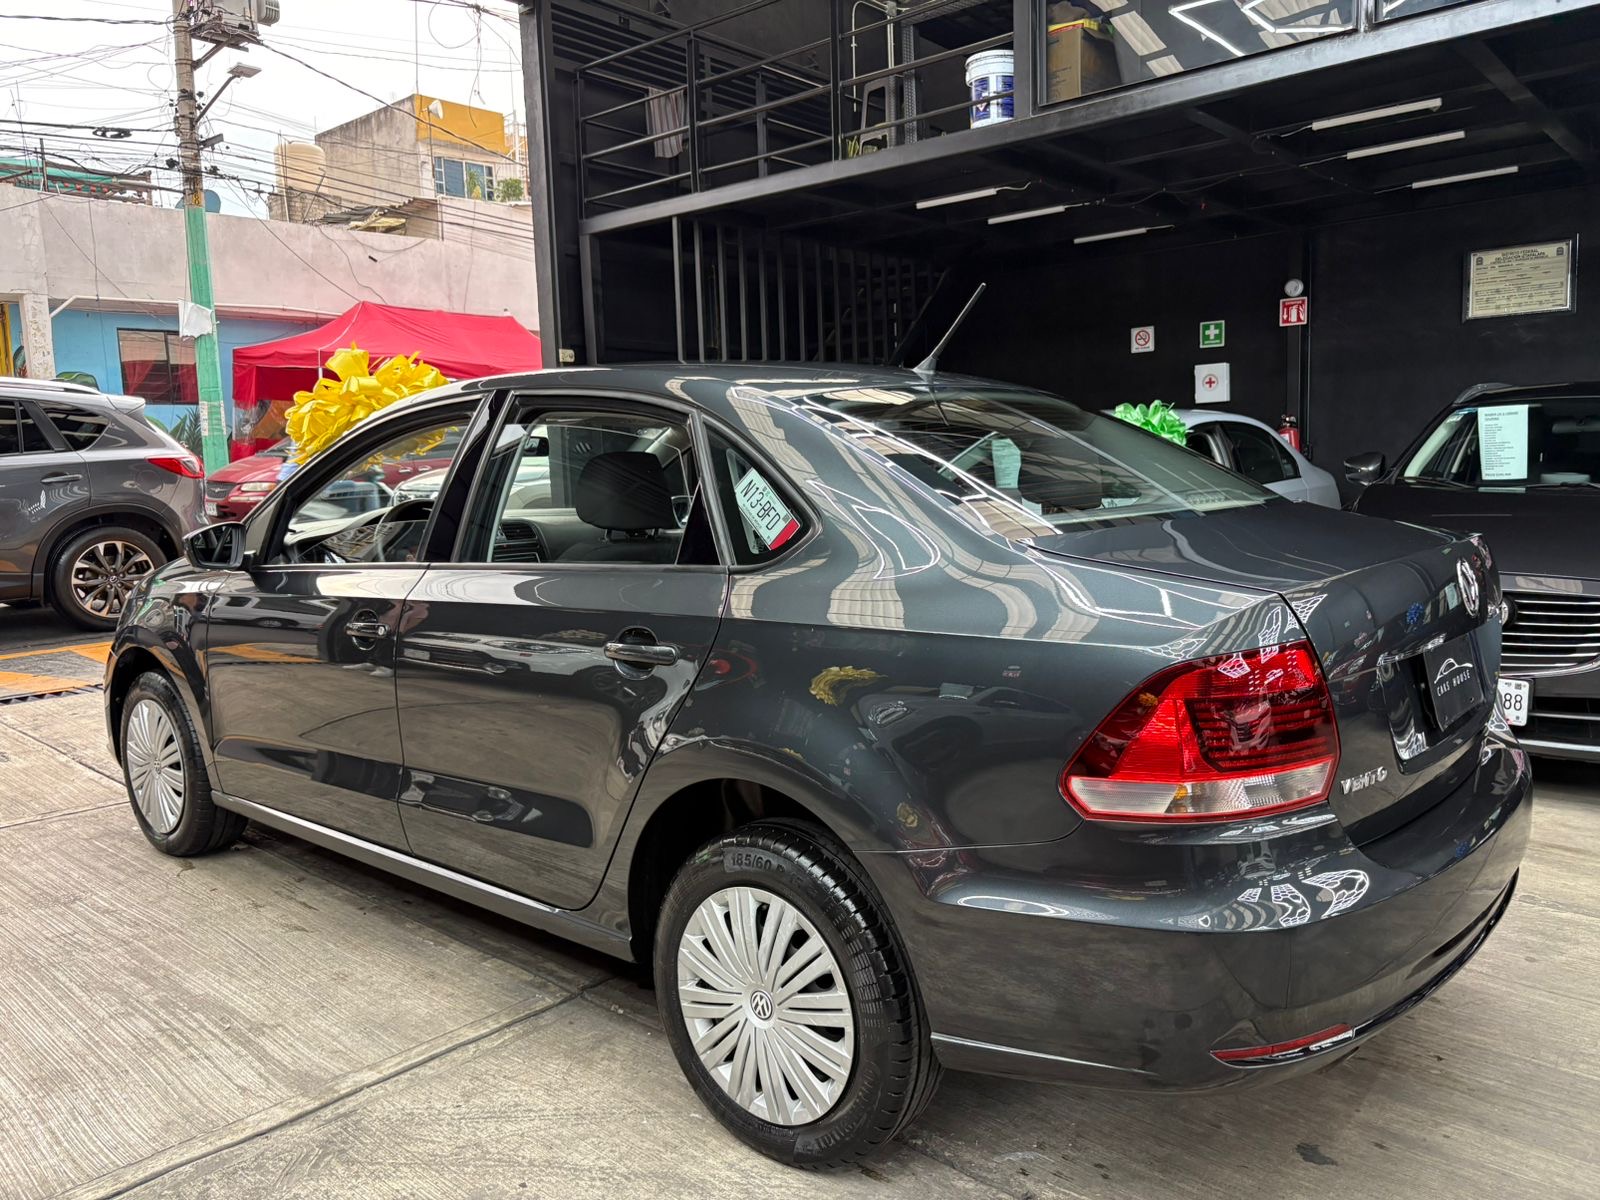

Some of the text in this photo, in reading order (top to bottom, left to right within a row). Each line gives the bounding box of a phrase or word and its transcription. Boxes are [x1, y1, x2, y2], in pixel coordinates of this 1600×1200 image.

[740, 479, 781, 531] N13-BFD
[1436, 669, 1471, 697] CARS HOUSE
[732, 853, 772, 870] 185/60
